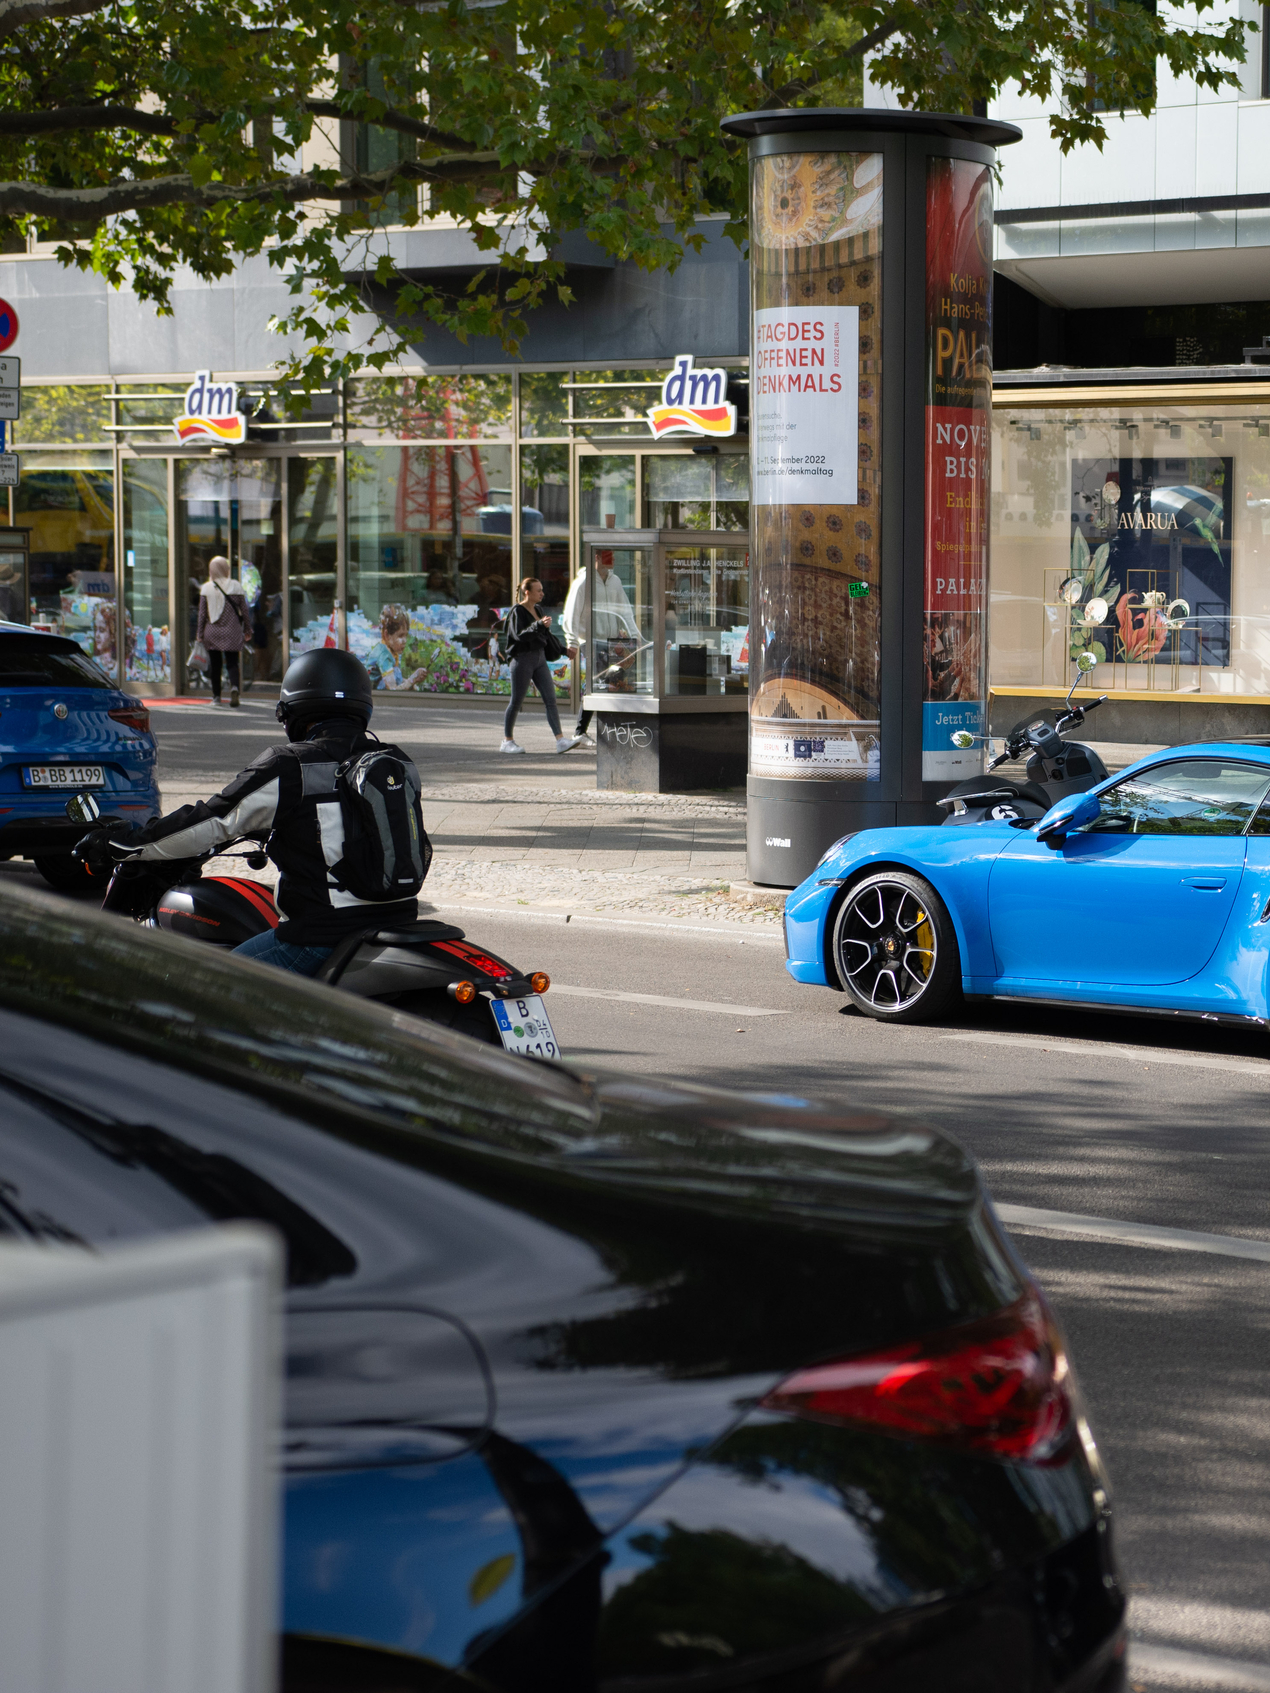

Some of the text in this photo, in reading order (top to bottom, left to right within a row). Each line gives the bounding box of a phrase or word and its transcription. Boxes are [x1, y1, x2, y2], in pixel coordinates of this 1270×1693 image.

[950, 273, 976, 297] Kolja
[757, 348, 825, 369] OFFENEN
[665, 358, 721, 406] dm
[757, 373, 842, 395] DENKMALS
[936, 384, 945, 393] Die
[185, 374, 236, 415] dm
[786, 422, 797, 430] der
[805, 455, 825, 464] 2022
[945, 456, 976, 479] BIS
[966, 518, 976, 532] in
[1117, 512, 1179, 529] AVARUA
[935, 712, 962, 725] Jetzt
[763, 743, 780, 751] BERLIN
[32, 768, 101, 783] B BB 1199
[773, 838, 791, 847] Wall
[516, 1000, 529, 1018] B
